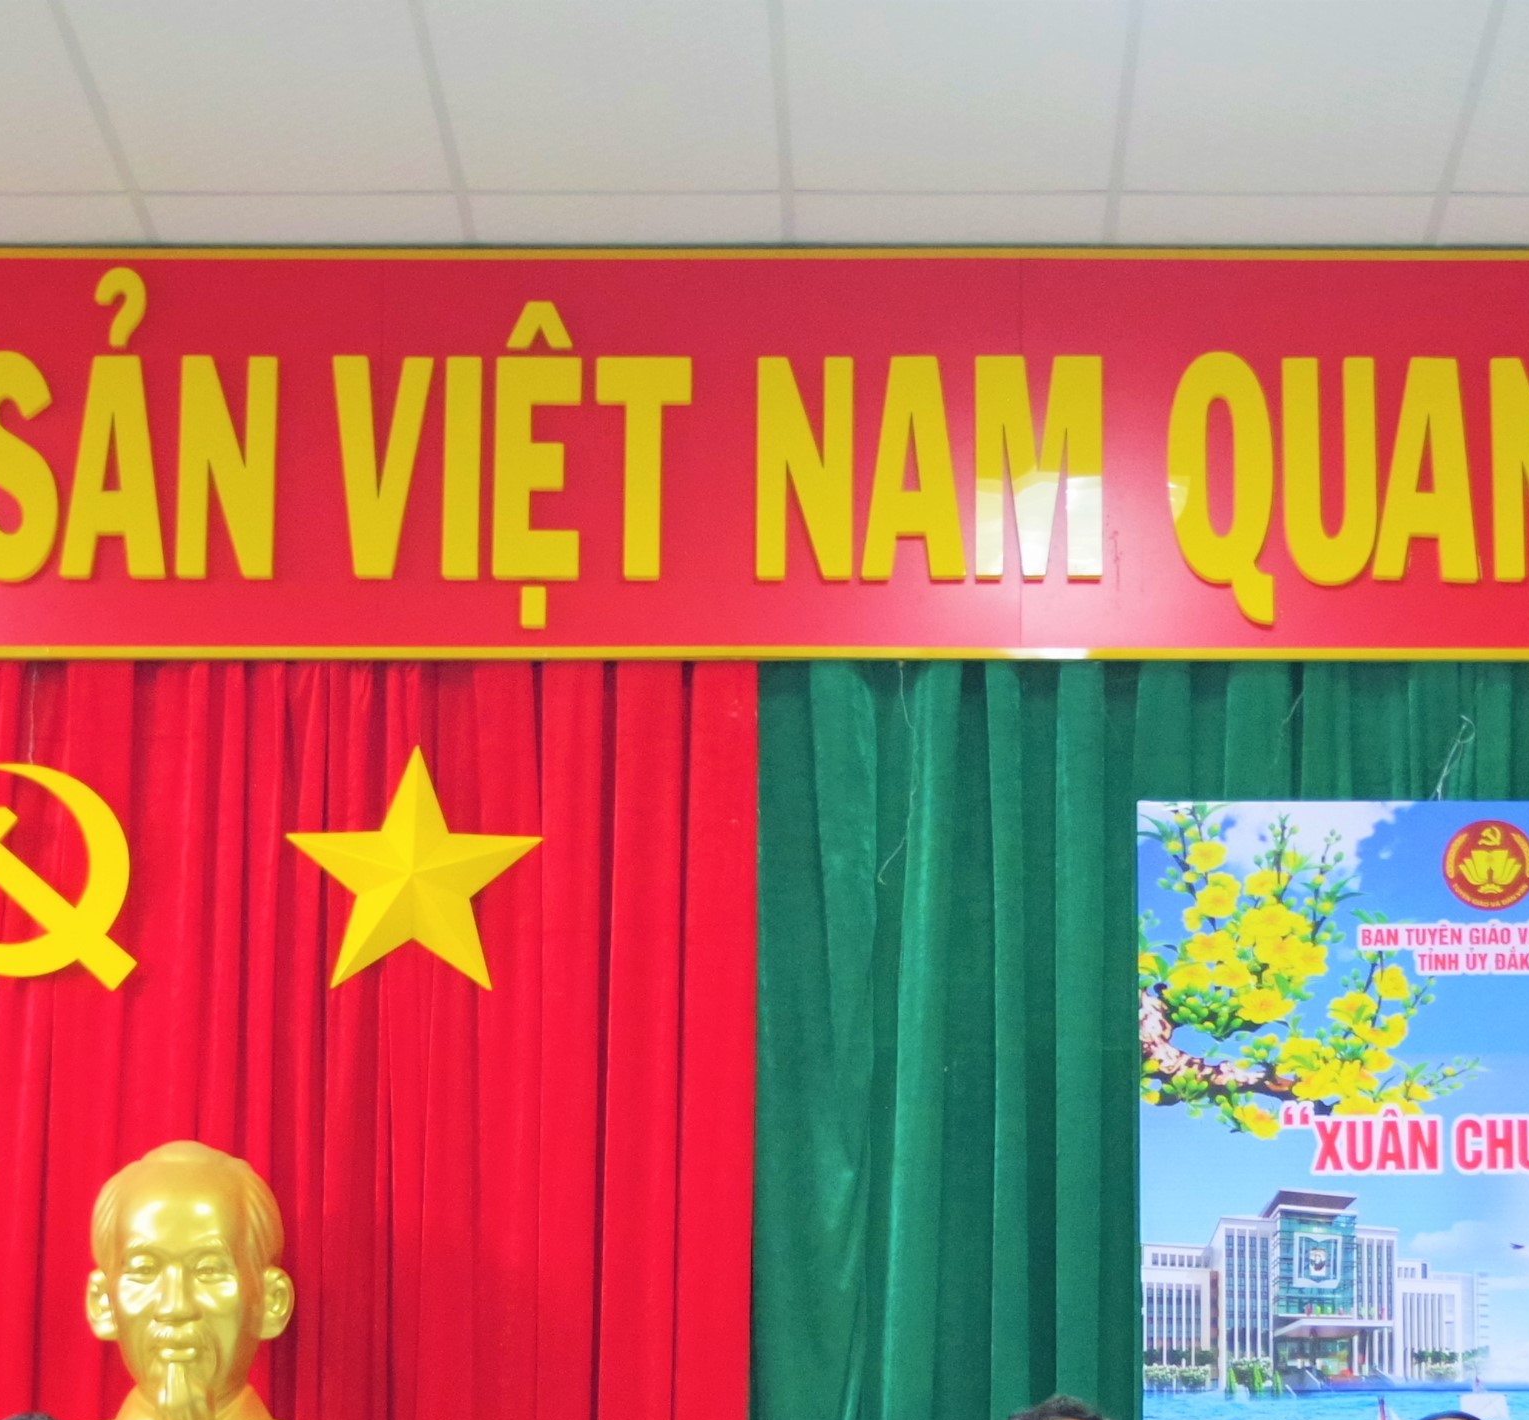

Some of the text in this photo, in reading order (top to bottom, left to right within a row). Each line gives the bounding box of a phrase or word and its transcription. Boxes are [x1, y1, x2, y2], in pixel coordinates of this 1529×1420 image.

[332, 300, 691, 629] VIỆT
[755, 354, 1103, 581] NAM
[1361, 927, 1399, 946] BAN
[1405, 923, 1462, 946] TUYÊN
[1470, 923, 1511, 946] GIÁO
[1418, 947, 1458, 971] TỈNH
[1465, 946, 1488, 971] ỦY
[1494, 946, 1529, 971] ĐẮK
